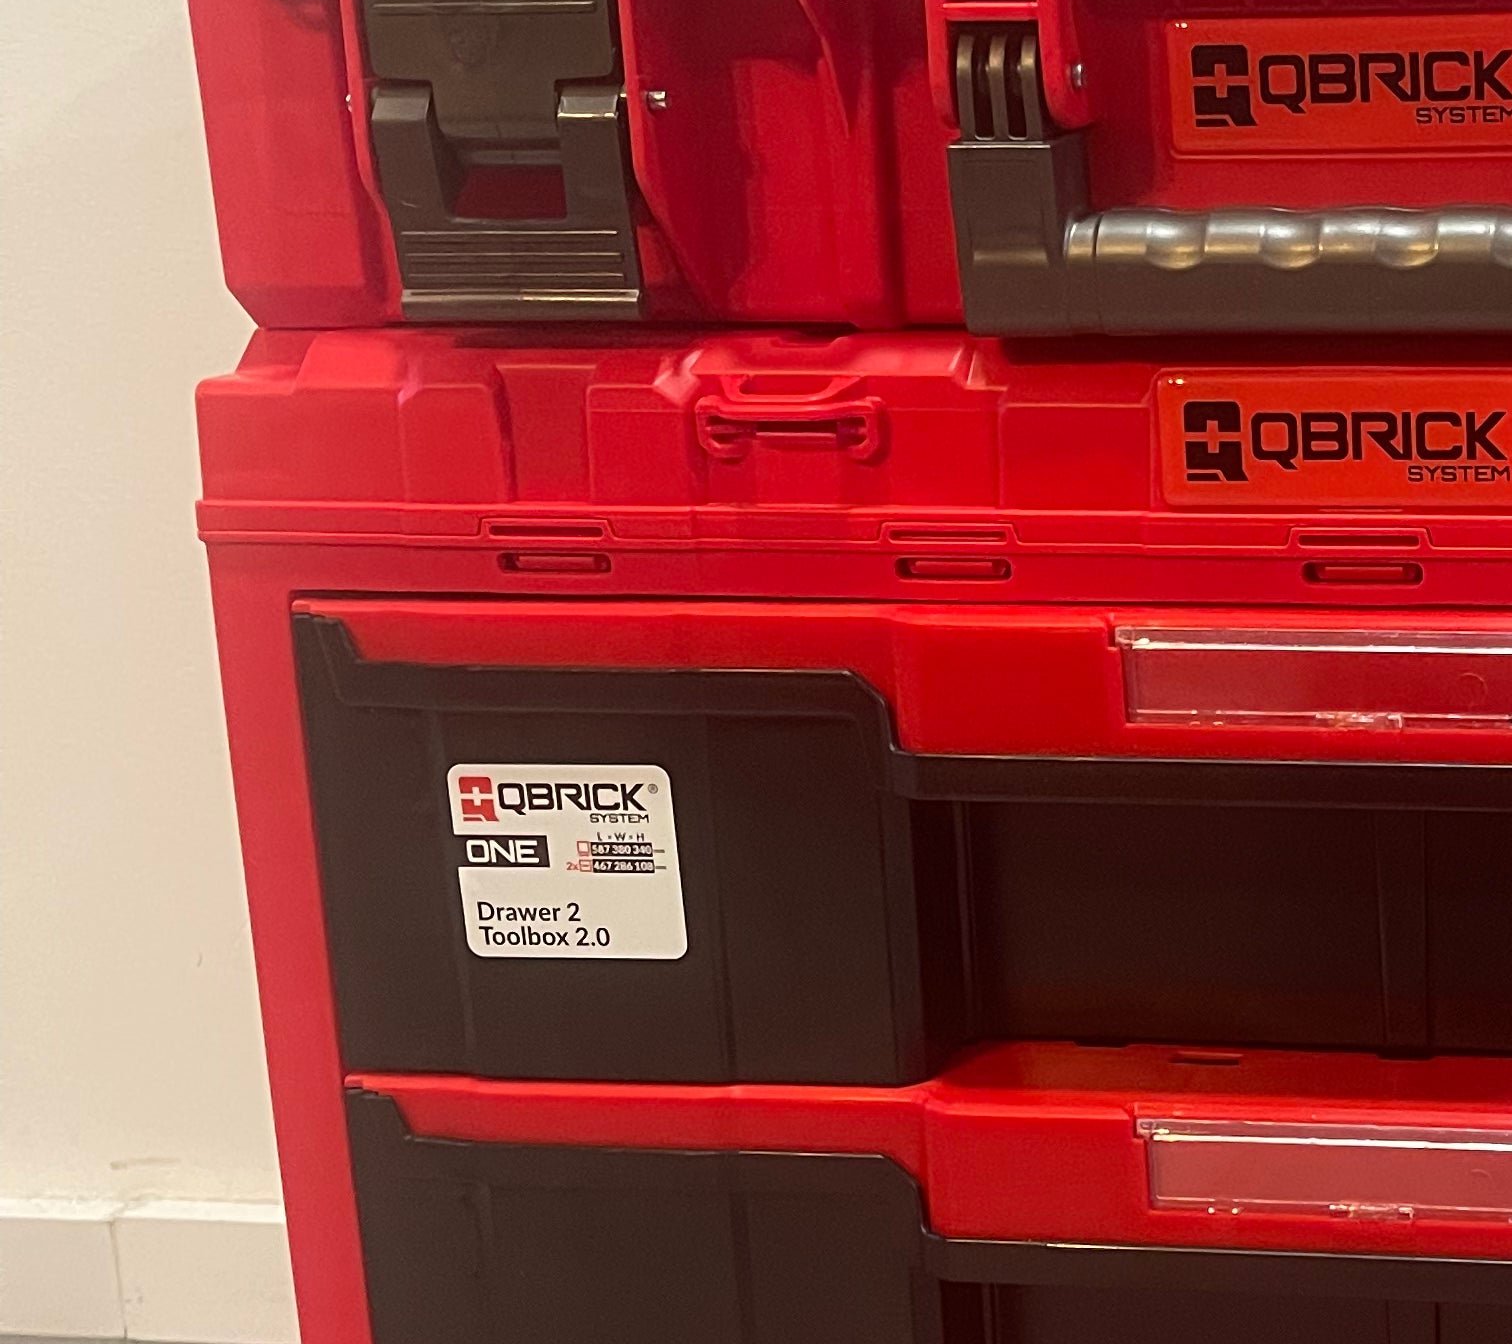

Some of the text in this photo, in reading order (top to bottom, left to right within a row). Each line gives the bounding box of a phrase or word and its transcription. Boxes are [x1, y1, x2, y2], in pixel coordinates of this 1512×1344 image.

[1407, 465, 1511, 483] SYSTEM
[589, 813, 650, 824] SYSTEM
[466, 839, 540, 863] ONE
[477, 901, 581, 922] Drawer 2
[479, 926, 611, 947] Toolbox 2.0
